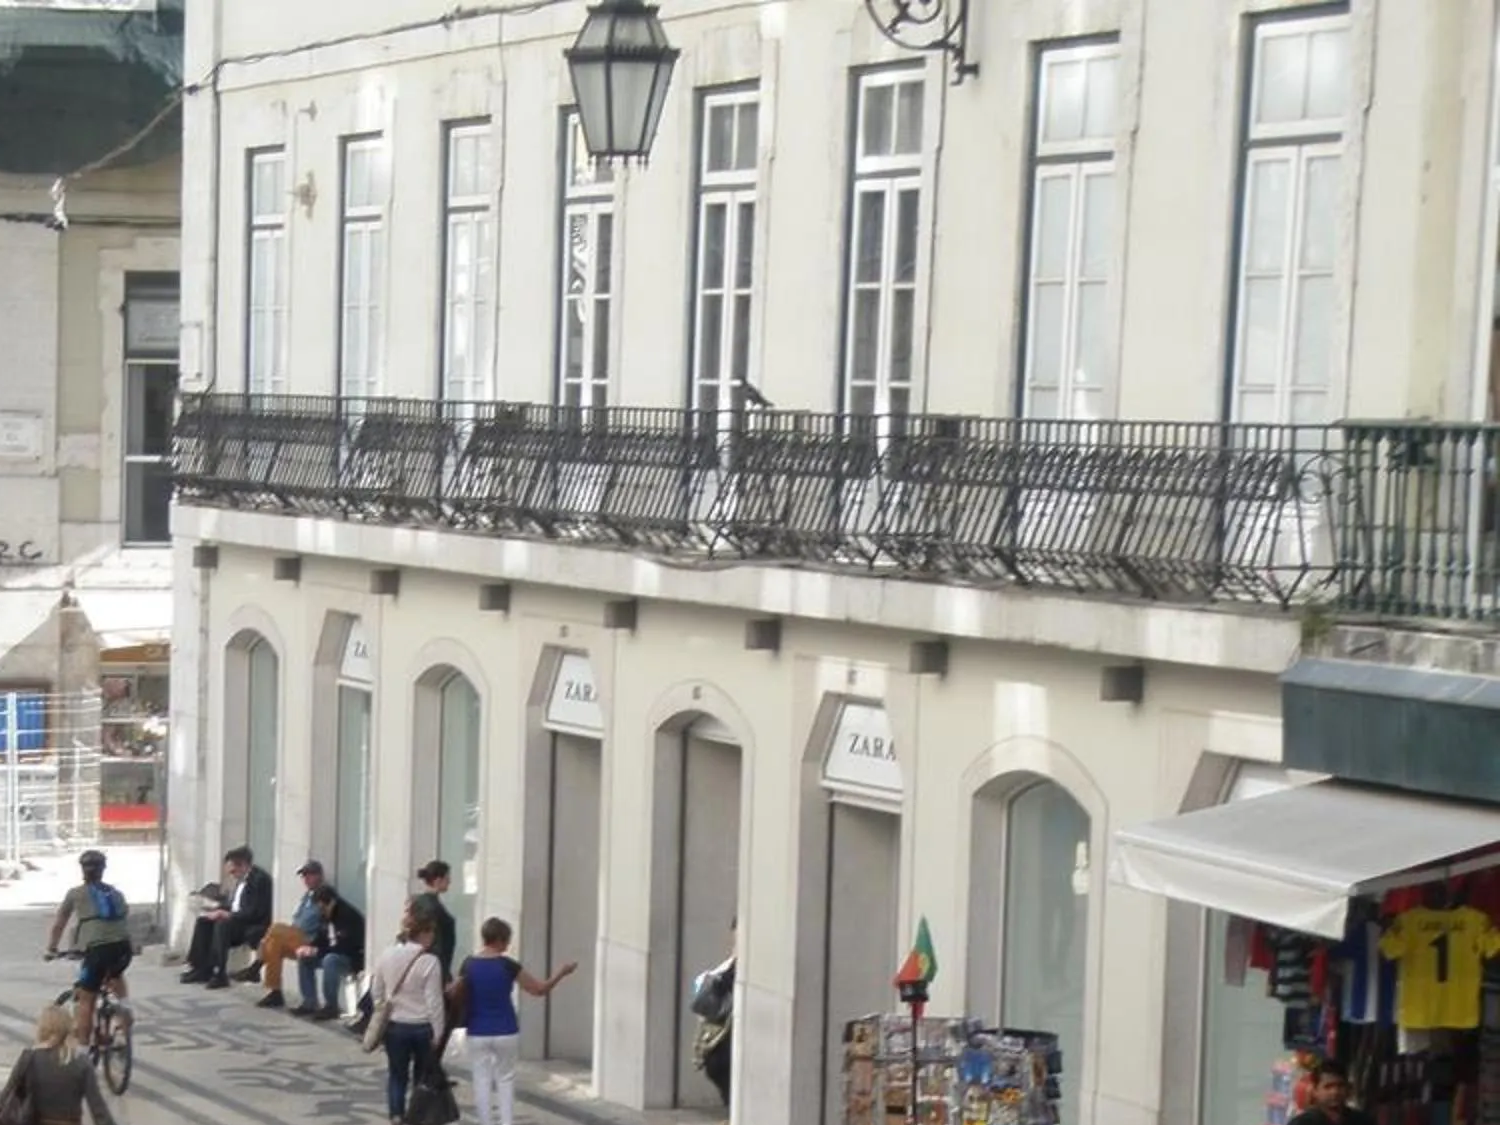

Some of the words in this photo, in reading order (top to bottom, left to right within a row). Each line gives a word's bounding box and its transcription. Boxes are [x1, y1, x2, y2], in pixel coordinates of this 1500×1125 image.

[354, 640, 370, 659] ZA
[848, 732, 897, 761] ZARA
[1429, 931, 1448, 982] 1
